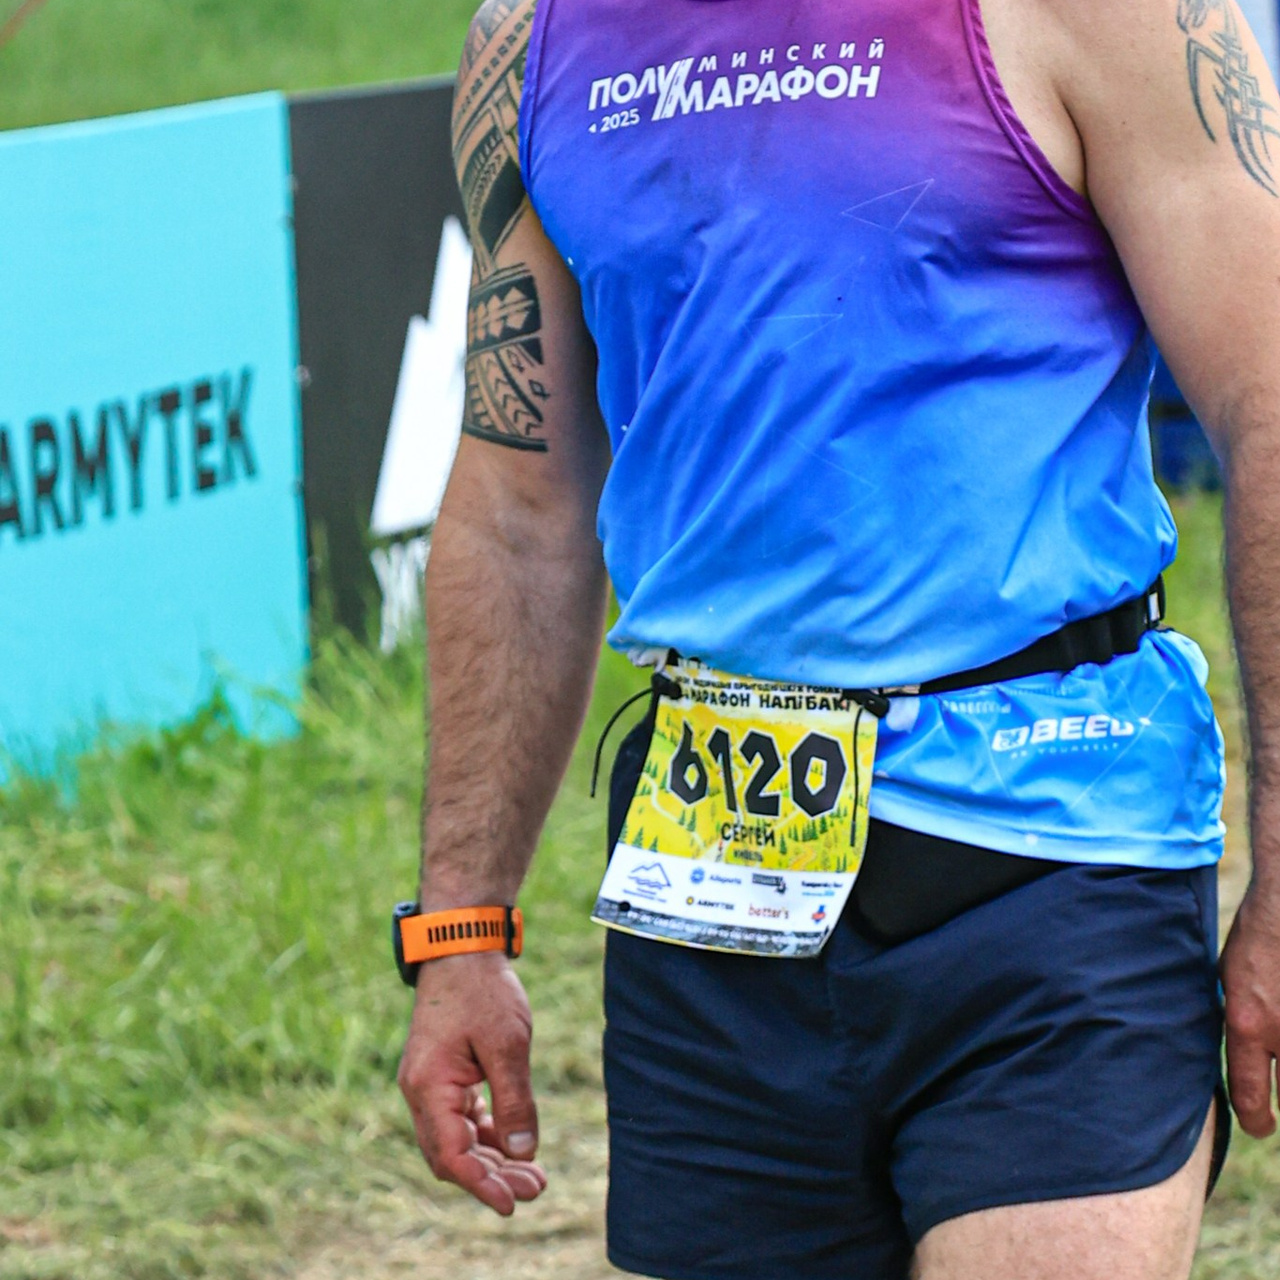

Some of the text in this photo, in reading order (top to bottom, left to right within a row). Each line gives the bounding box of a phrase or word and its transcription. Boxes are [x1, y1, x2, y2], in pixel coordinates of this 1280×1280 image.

[697, 38, 885, 73] МИНСКИЙ
[600, 107, 641, 133] 2025
[668, 720, 847, 818] 6120
[720, 822, 776, 847] СЕРГЕЙ
